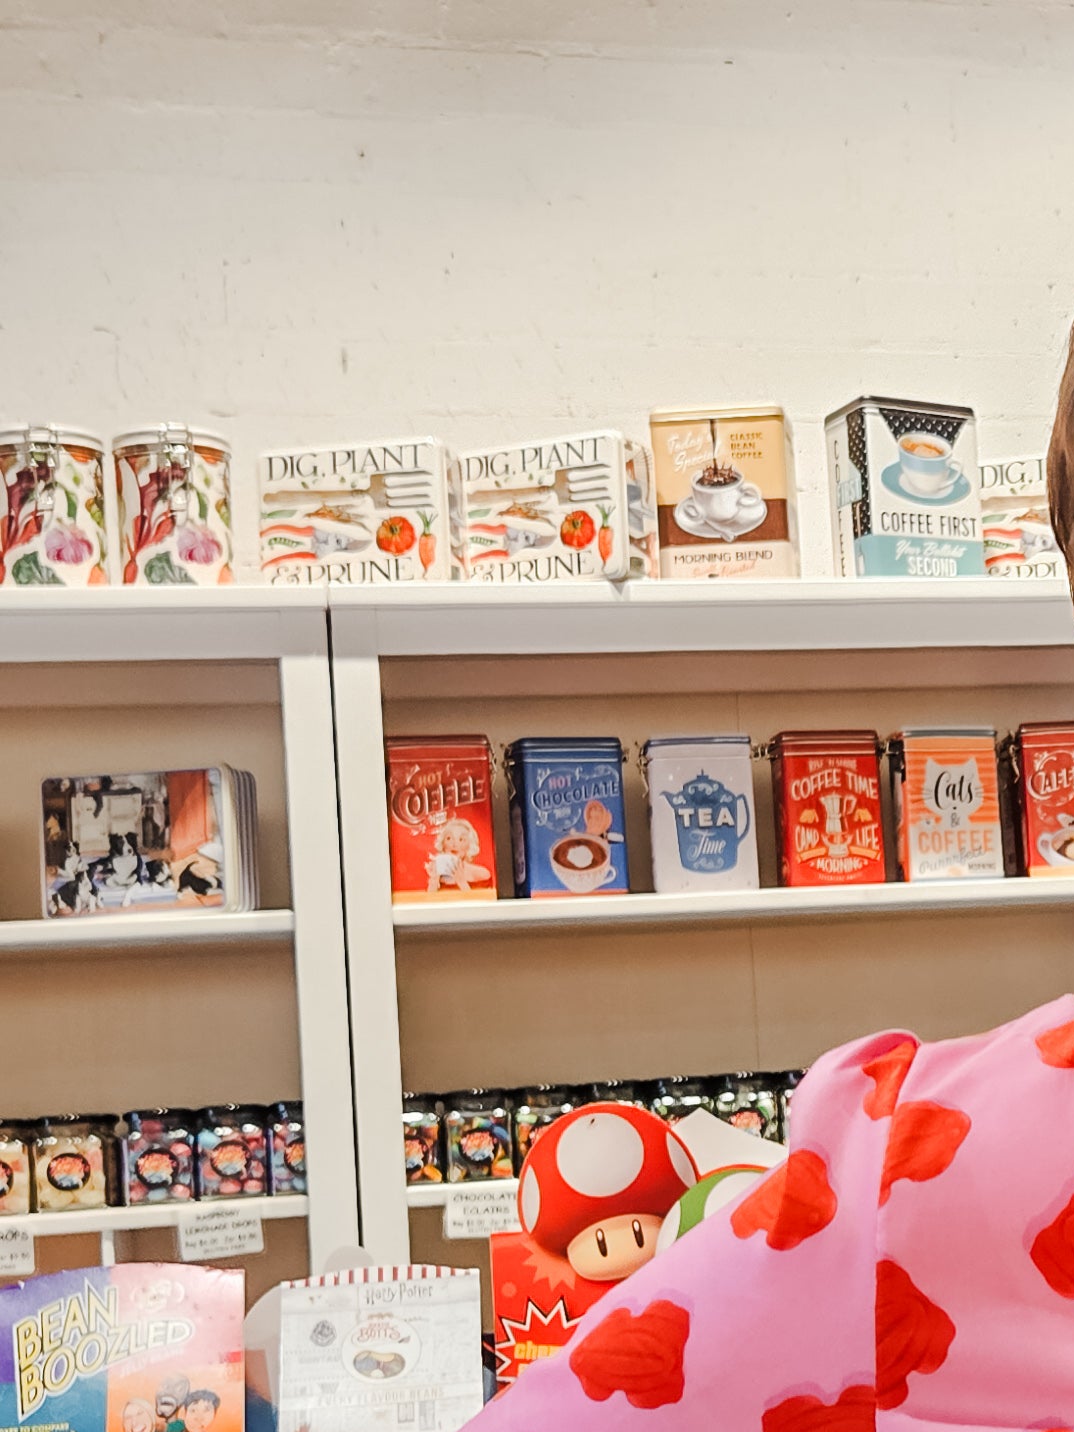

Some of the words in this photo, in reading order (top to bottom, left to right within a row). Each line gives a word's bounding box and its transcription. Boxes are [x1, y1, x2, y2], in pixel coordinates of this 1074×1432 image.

[331, 443, 433, 474] PLANT
[521, 436, 606, 472] PLANT
[881, 511, 934, 535] COFFEE
[939, 515, 978, 538] FIRST
[500, 551, 594, 582] PRUNE
[674, 552, 732, 564] MORNING
[736, 550, 773, 562] BLEND
[908, 556, 958, 577] SECOND
[307, 557, 415, 585] PRUNE
[549, 775, 571, 789] HOT
[791, 768, 841, 801] COFFEE
[845, 770, 879, 800] TIME
[934, 770, 973, 810] Cats
[391, 776, 487, 827] COFFEE
[531, 781, 620, 811] CHOCOLATE
[678, 808, 734, 828] TEA
[688, 832, 726, 859] Time
[795, 825, 819, 852] CAMP
[855, 823, 880, 850] LIFE
[918, 829, 994, 854] COFFEE
[816, 857, 863, 873] MORNING
[366, 1286, 397, 1305] Harry
[399, 1282, 433, 1302] Potter
[16, 1280, 118, 1370] BEAN
[20, 1318, 193, 1416] BOOZLED
